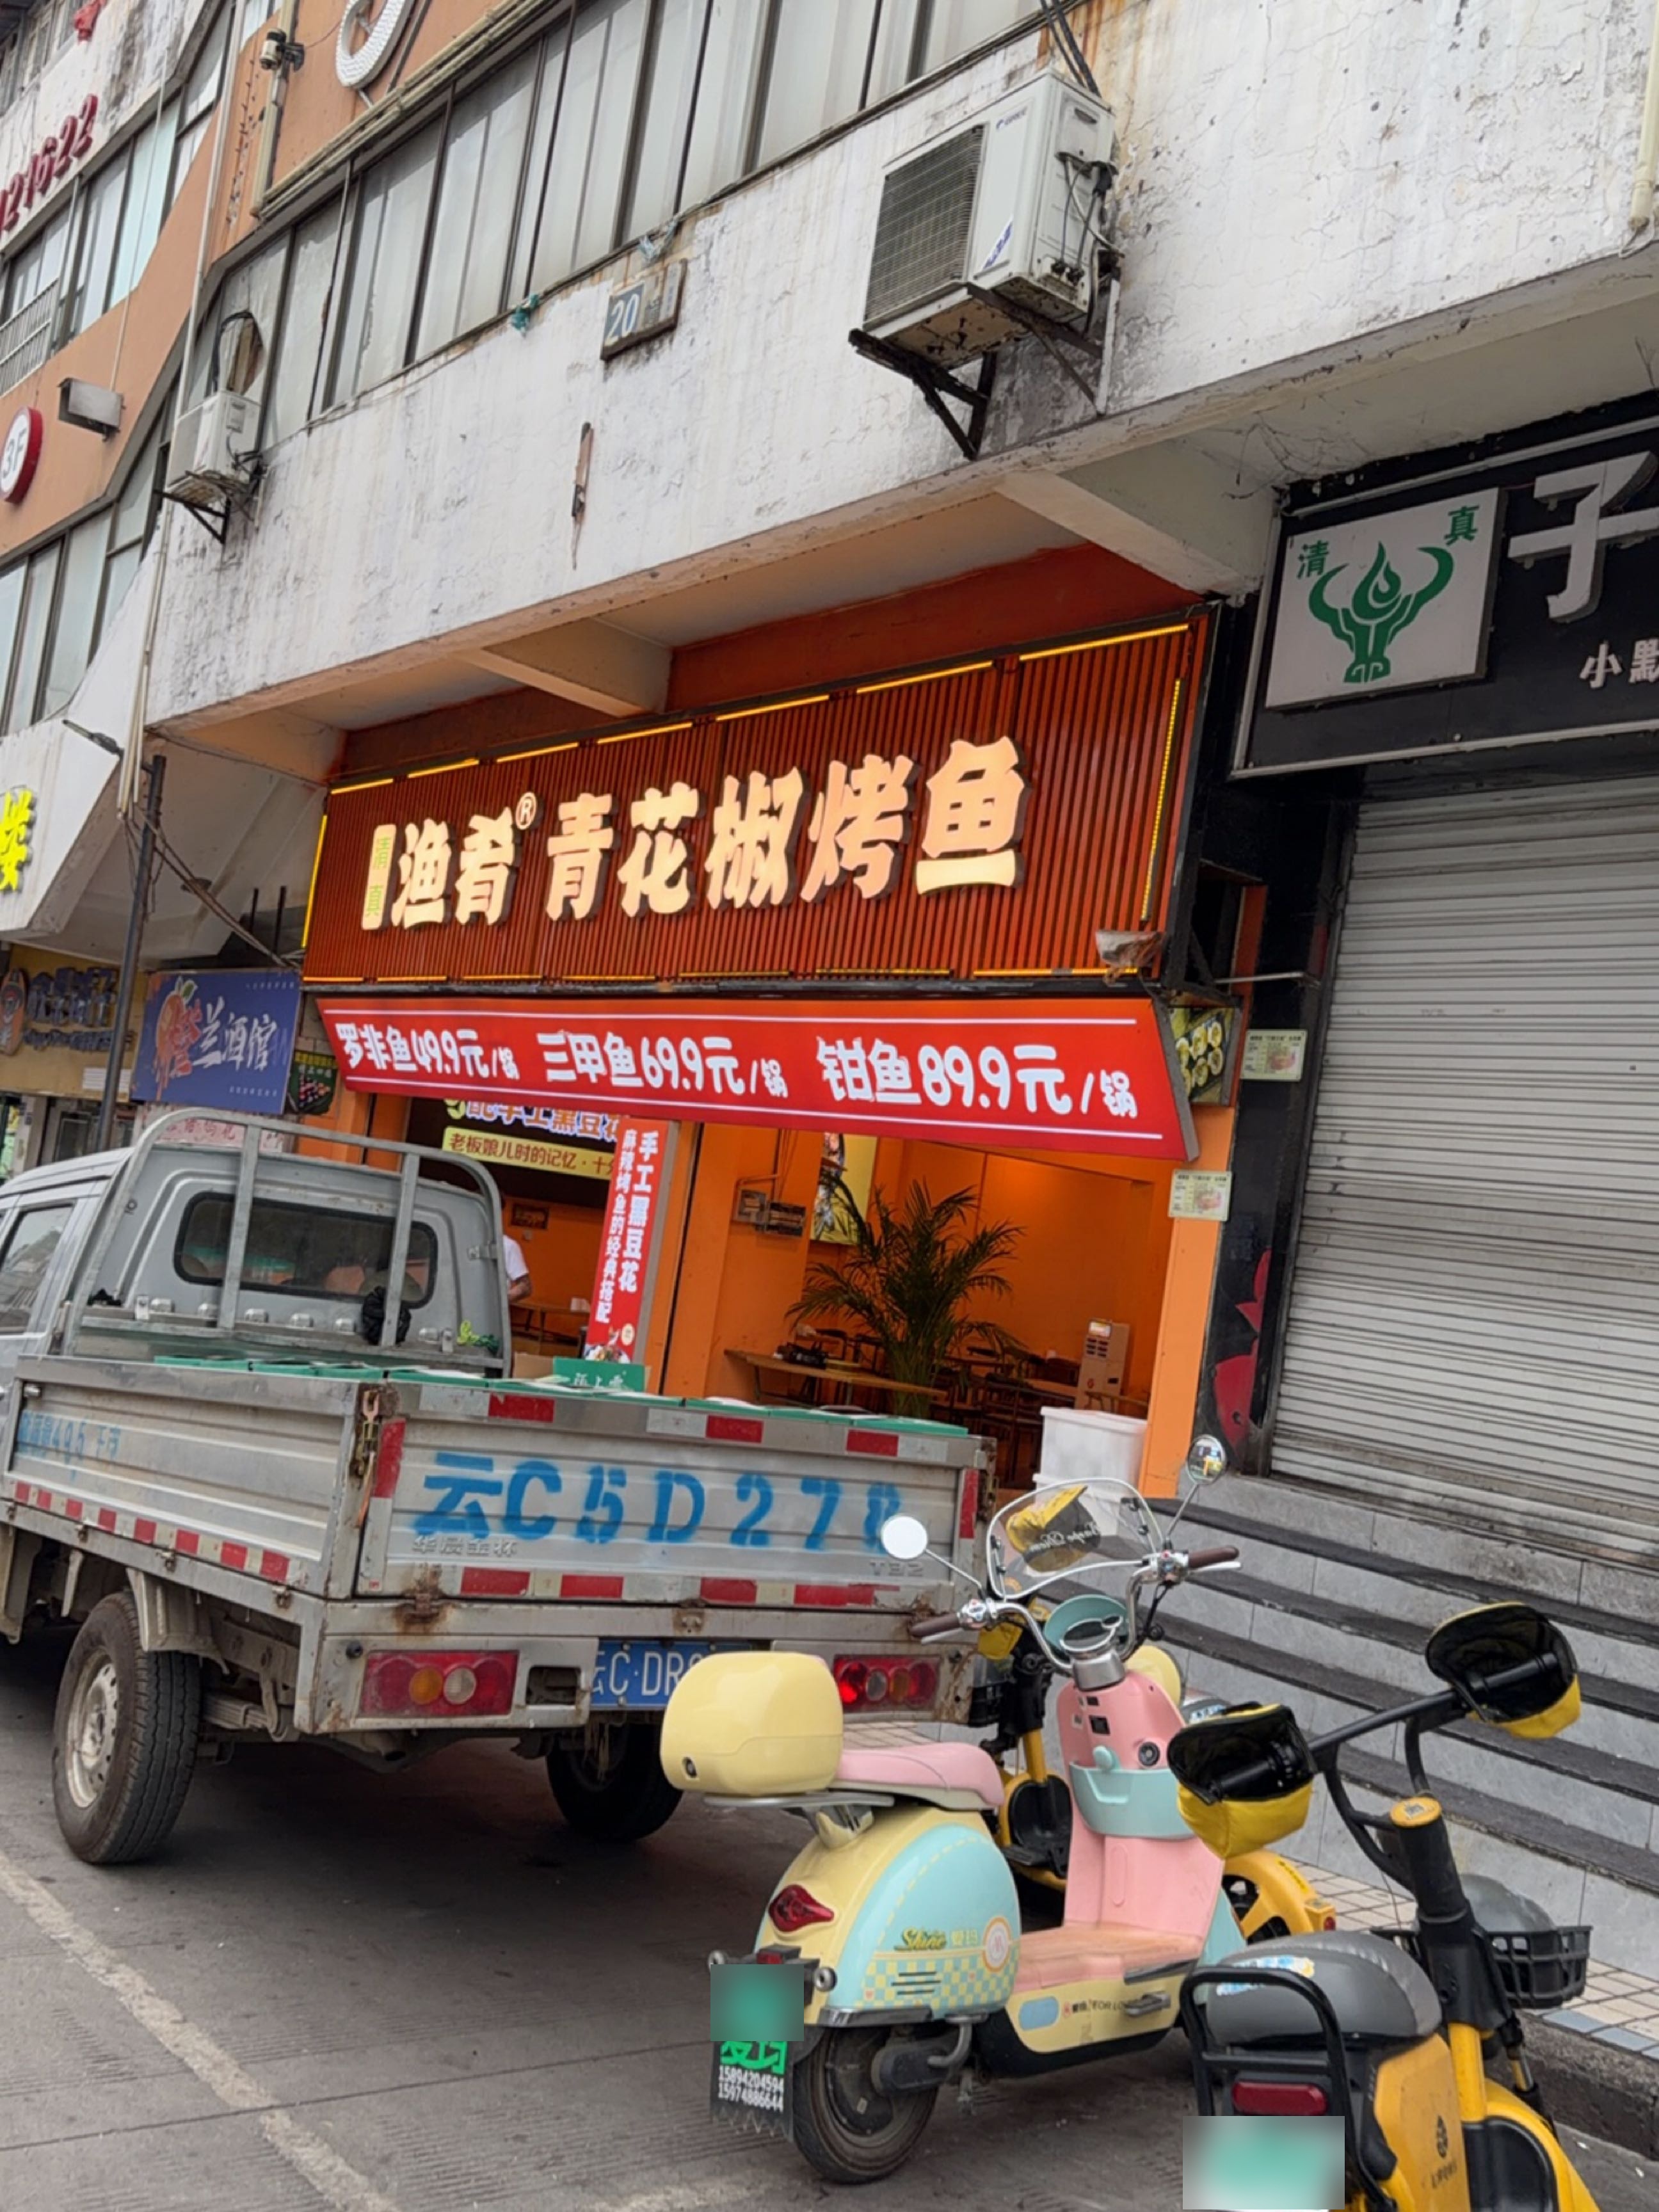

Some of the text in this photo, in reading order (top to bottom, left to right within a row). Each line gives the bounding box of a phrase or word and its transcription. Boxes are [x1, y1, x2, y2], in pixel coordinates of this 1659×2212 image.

[605, 293, 639, 346] 20
[1445, 506, 1479, 545] 真
[547, 735, 1025, 922] 青花椒烤鱼
[335, 1022, 1138, 1119] 罗非鱼49.9元/锅 三甲鱼69.9元/锅 钳鱼89.9元/锅
[618, 1131, 659, 1292] 手工黑豆花
